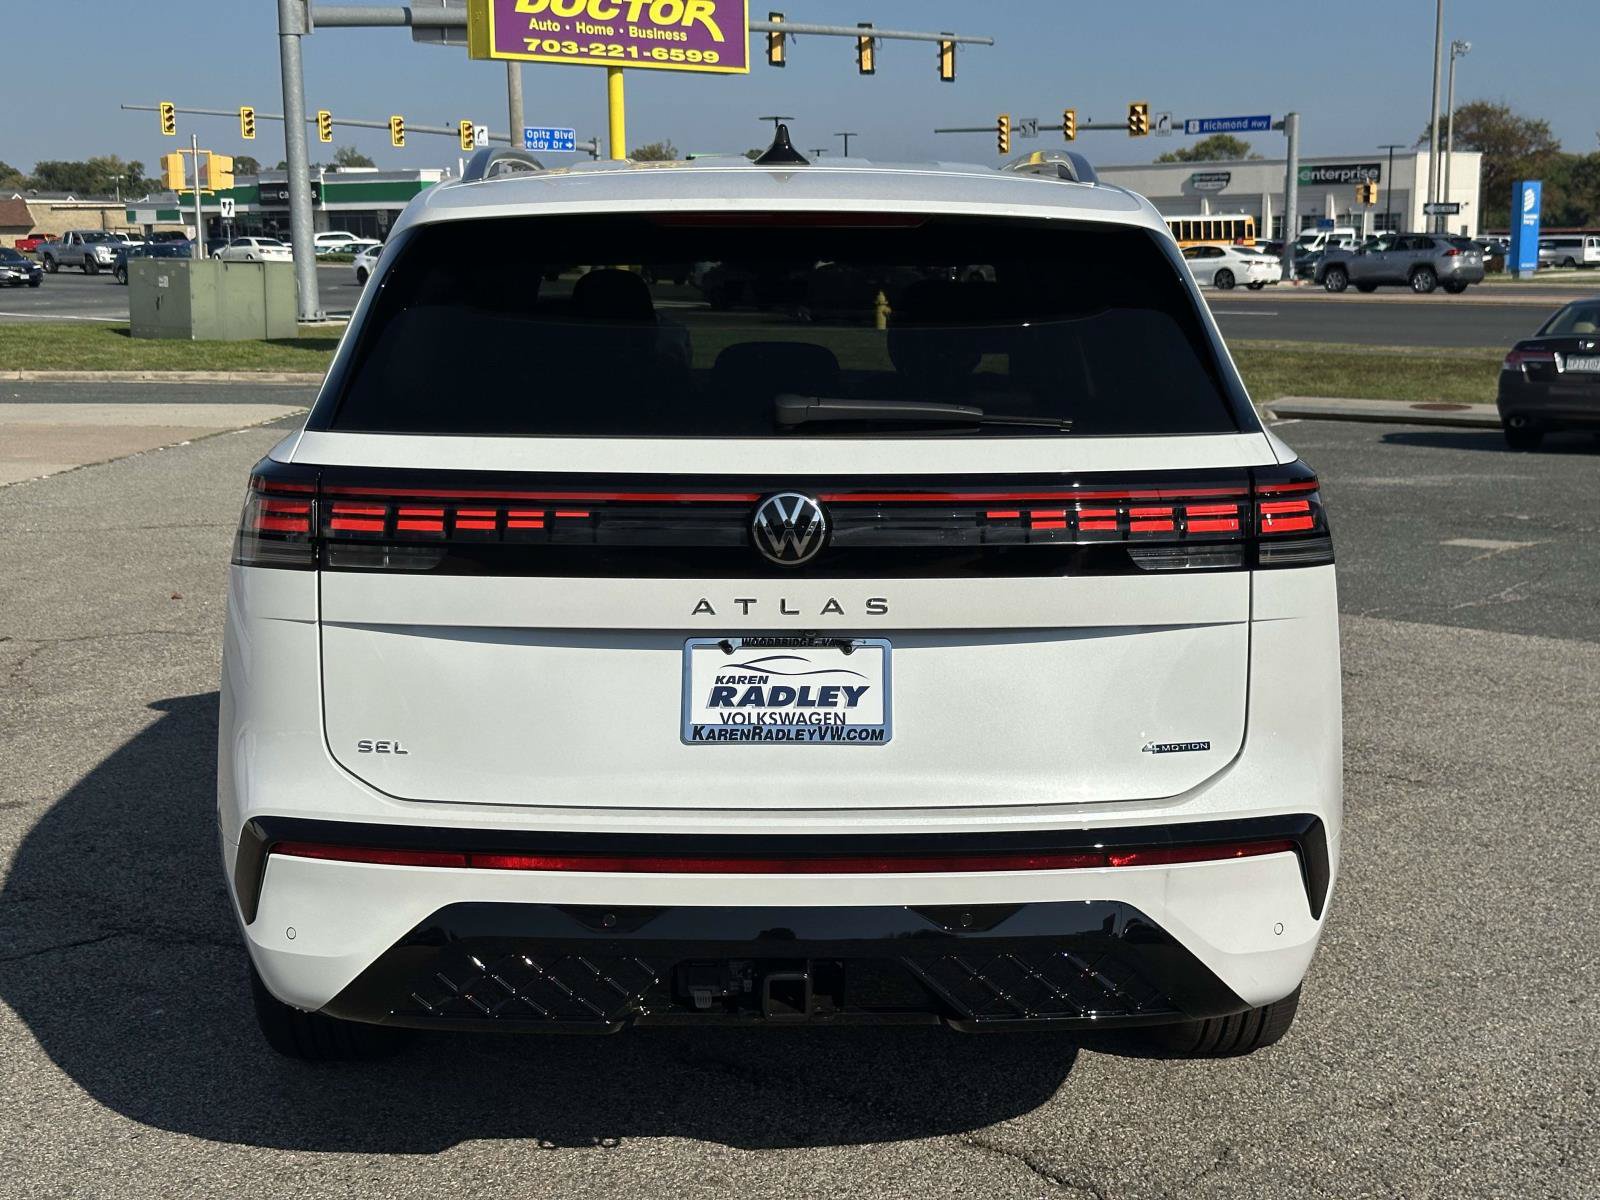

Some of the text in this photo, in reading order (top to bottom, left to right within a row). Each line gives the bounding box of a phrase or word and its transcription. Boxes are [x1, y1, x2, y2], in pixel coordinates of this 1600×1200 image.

[515, 0, 724, 42] DOCTOR
[529, 18, 687, 41] Auto Home Business
[523, 38, 720, 63] 703-221-6599
[1203, 119, 1248, 131] Richmond
[526, 130, 574, 140] Opitz Blvd
[524, 140, 563, 150] eddy Dr
[1300, 166, 1378, 182] enterprise
[691, 598, 889, 616] ATLAS
[714, 675, 769, 685] KAREN
[706, 685, 870, 709] RADLEY
[719, 711, 846, 725] VOLKSWAGEN
[357, 740, 409, 754] SEL
